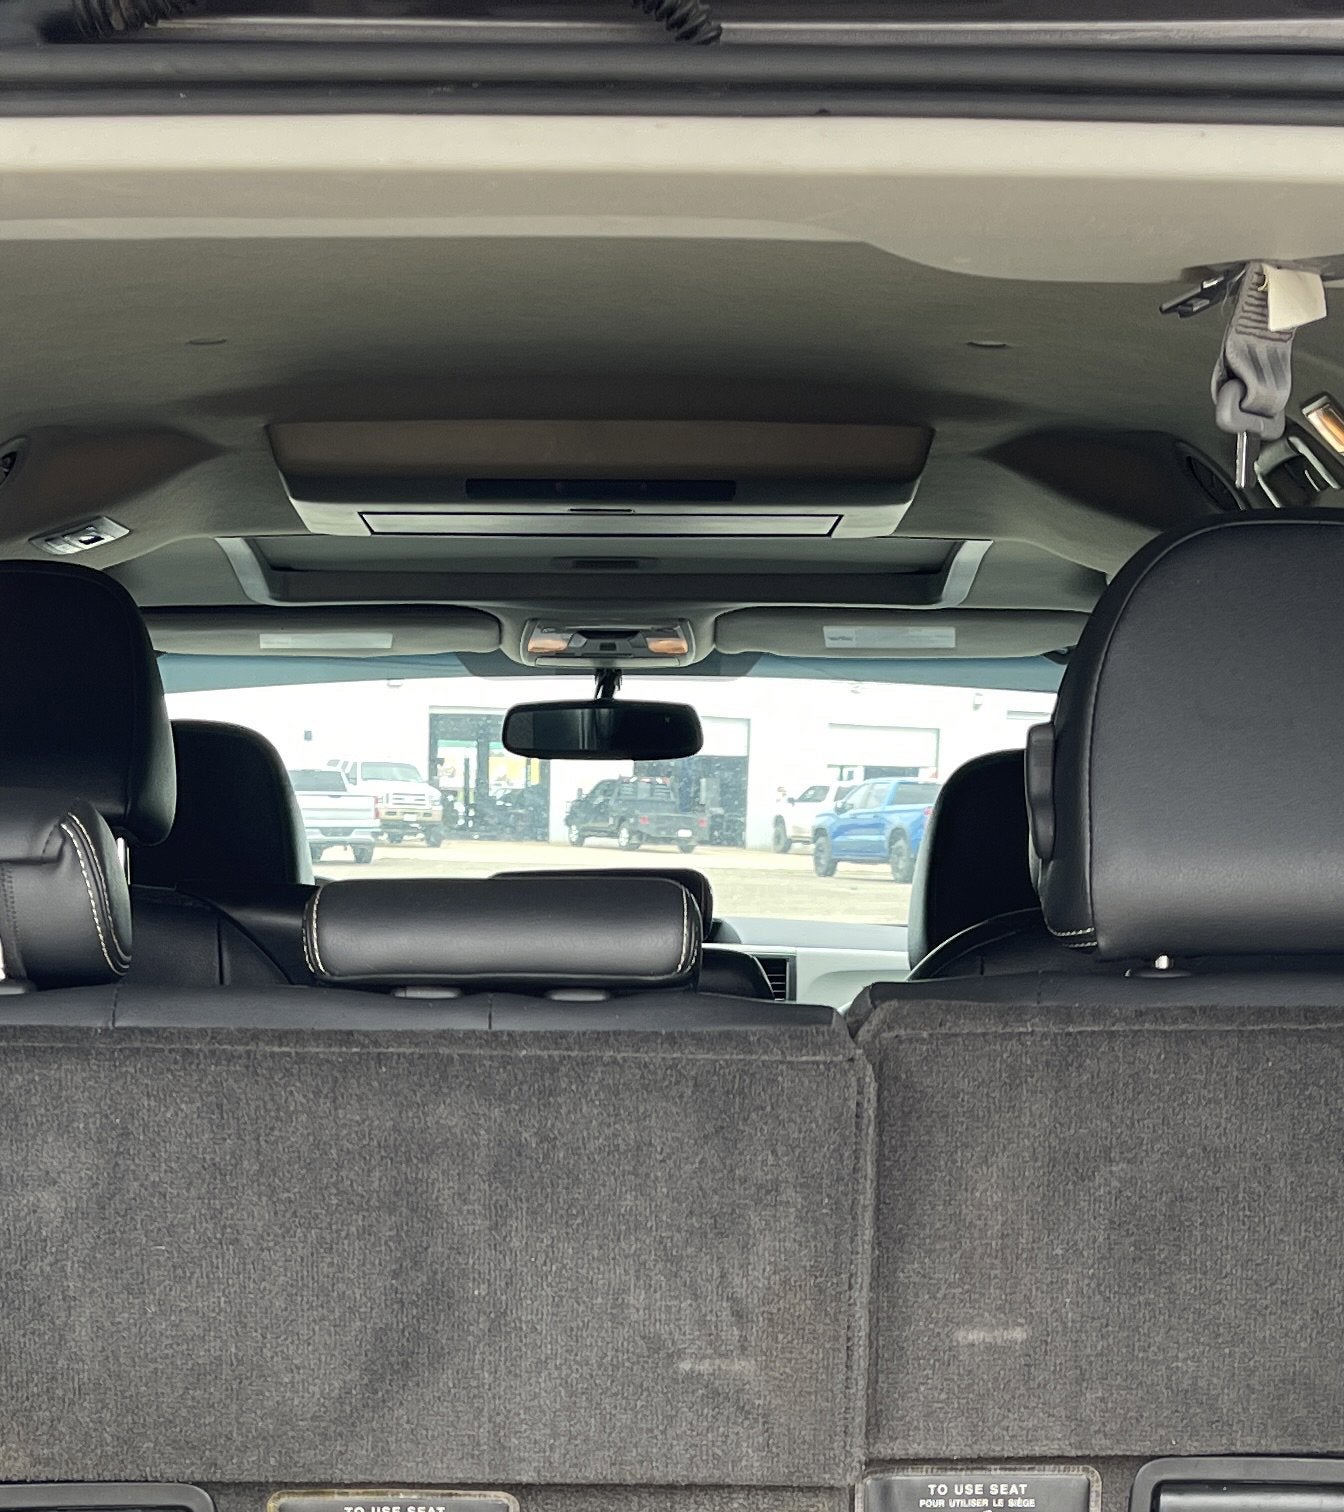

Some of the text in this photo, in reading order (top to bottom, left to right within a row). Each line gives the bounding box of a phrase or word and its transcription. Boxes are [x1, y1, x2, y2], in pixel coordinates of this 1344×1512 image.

[928, 1484, 1027, 1495] TO USE SEAT
[919, 1499, 944, 1508] POUR
[949, 1499, 988, 1508] UTILISER
[992, 1498, 1004, 1507] LE
